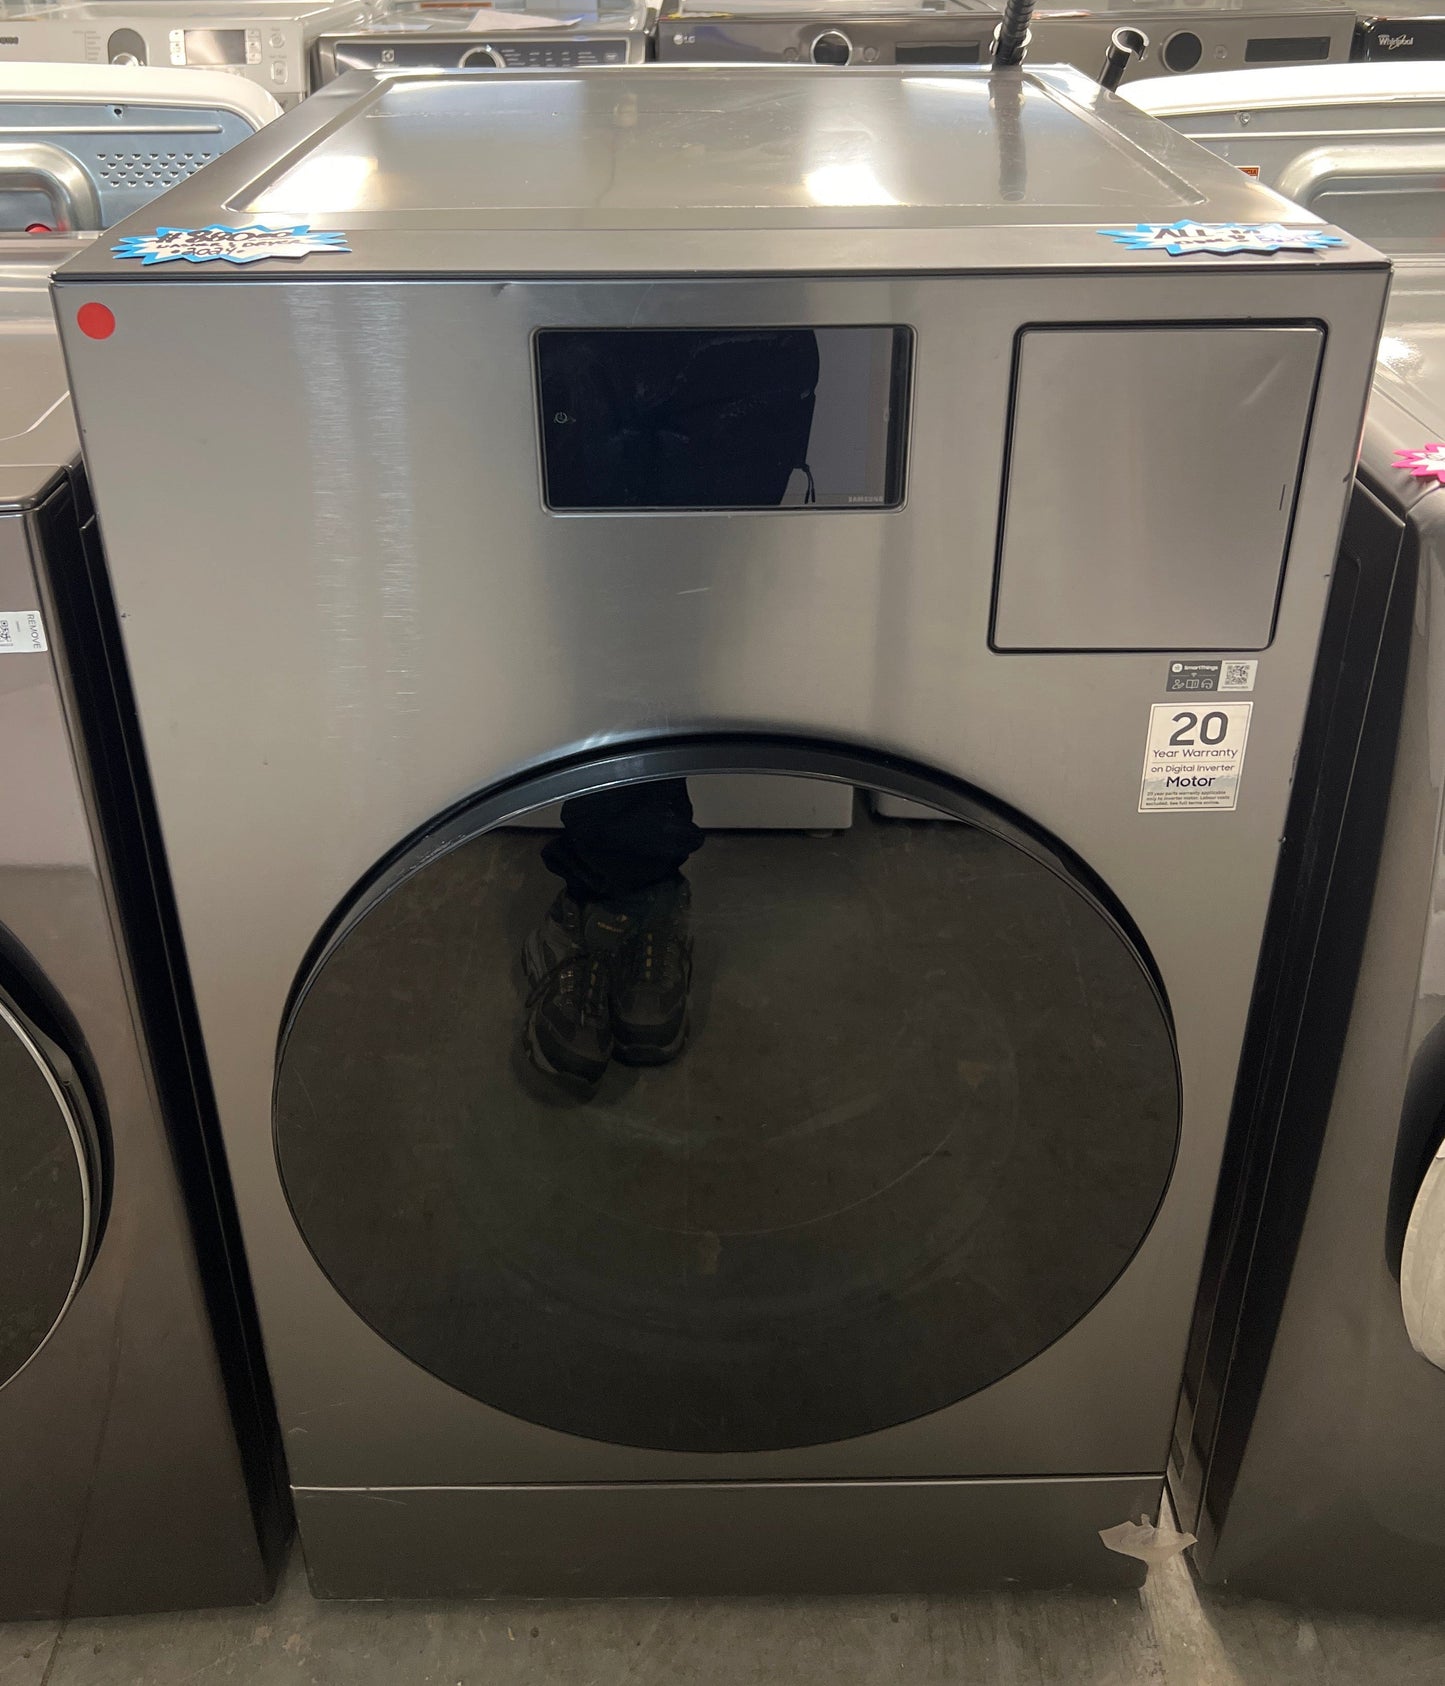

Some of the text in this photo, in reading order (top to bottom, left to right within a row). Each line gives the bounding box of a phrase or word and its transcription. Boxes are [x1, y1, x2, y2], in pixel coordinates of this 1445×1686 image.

[1378, 34, 1414, 50] Whirlpool
[848, 495, 884, 503] SAMSUNG
[27, 614, 41, 649] REMOVE
[1169, 711, 1229, 747] 20
[1153, 748, 1239, 760] Year Warranty
[1165, 765, 1195, 775] Digital
[1196, 764, 1235, 773] Inverter
[1166, 776, 1216, 788] Motor
